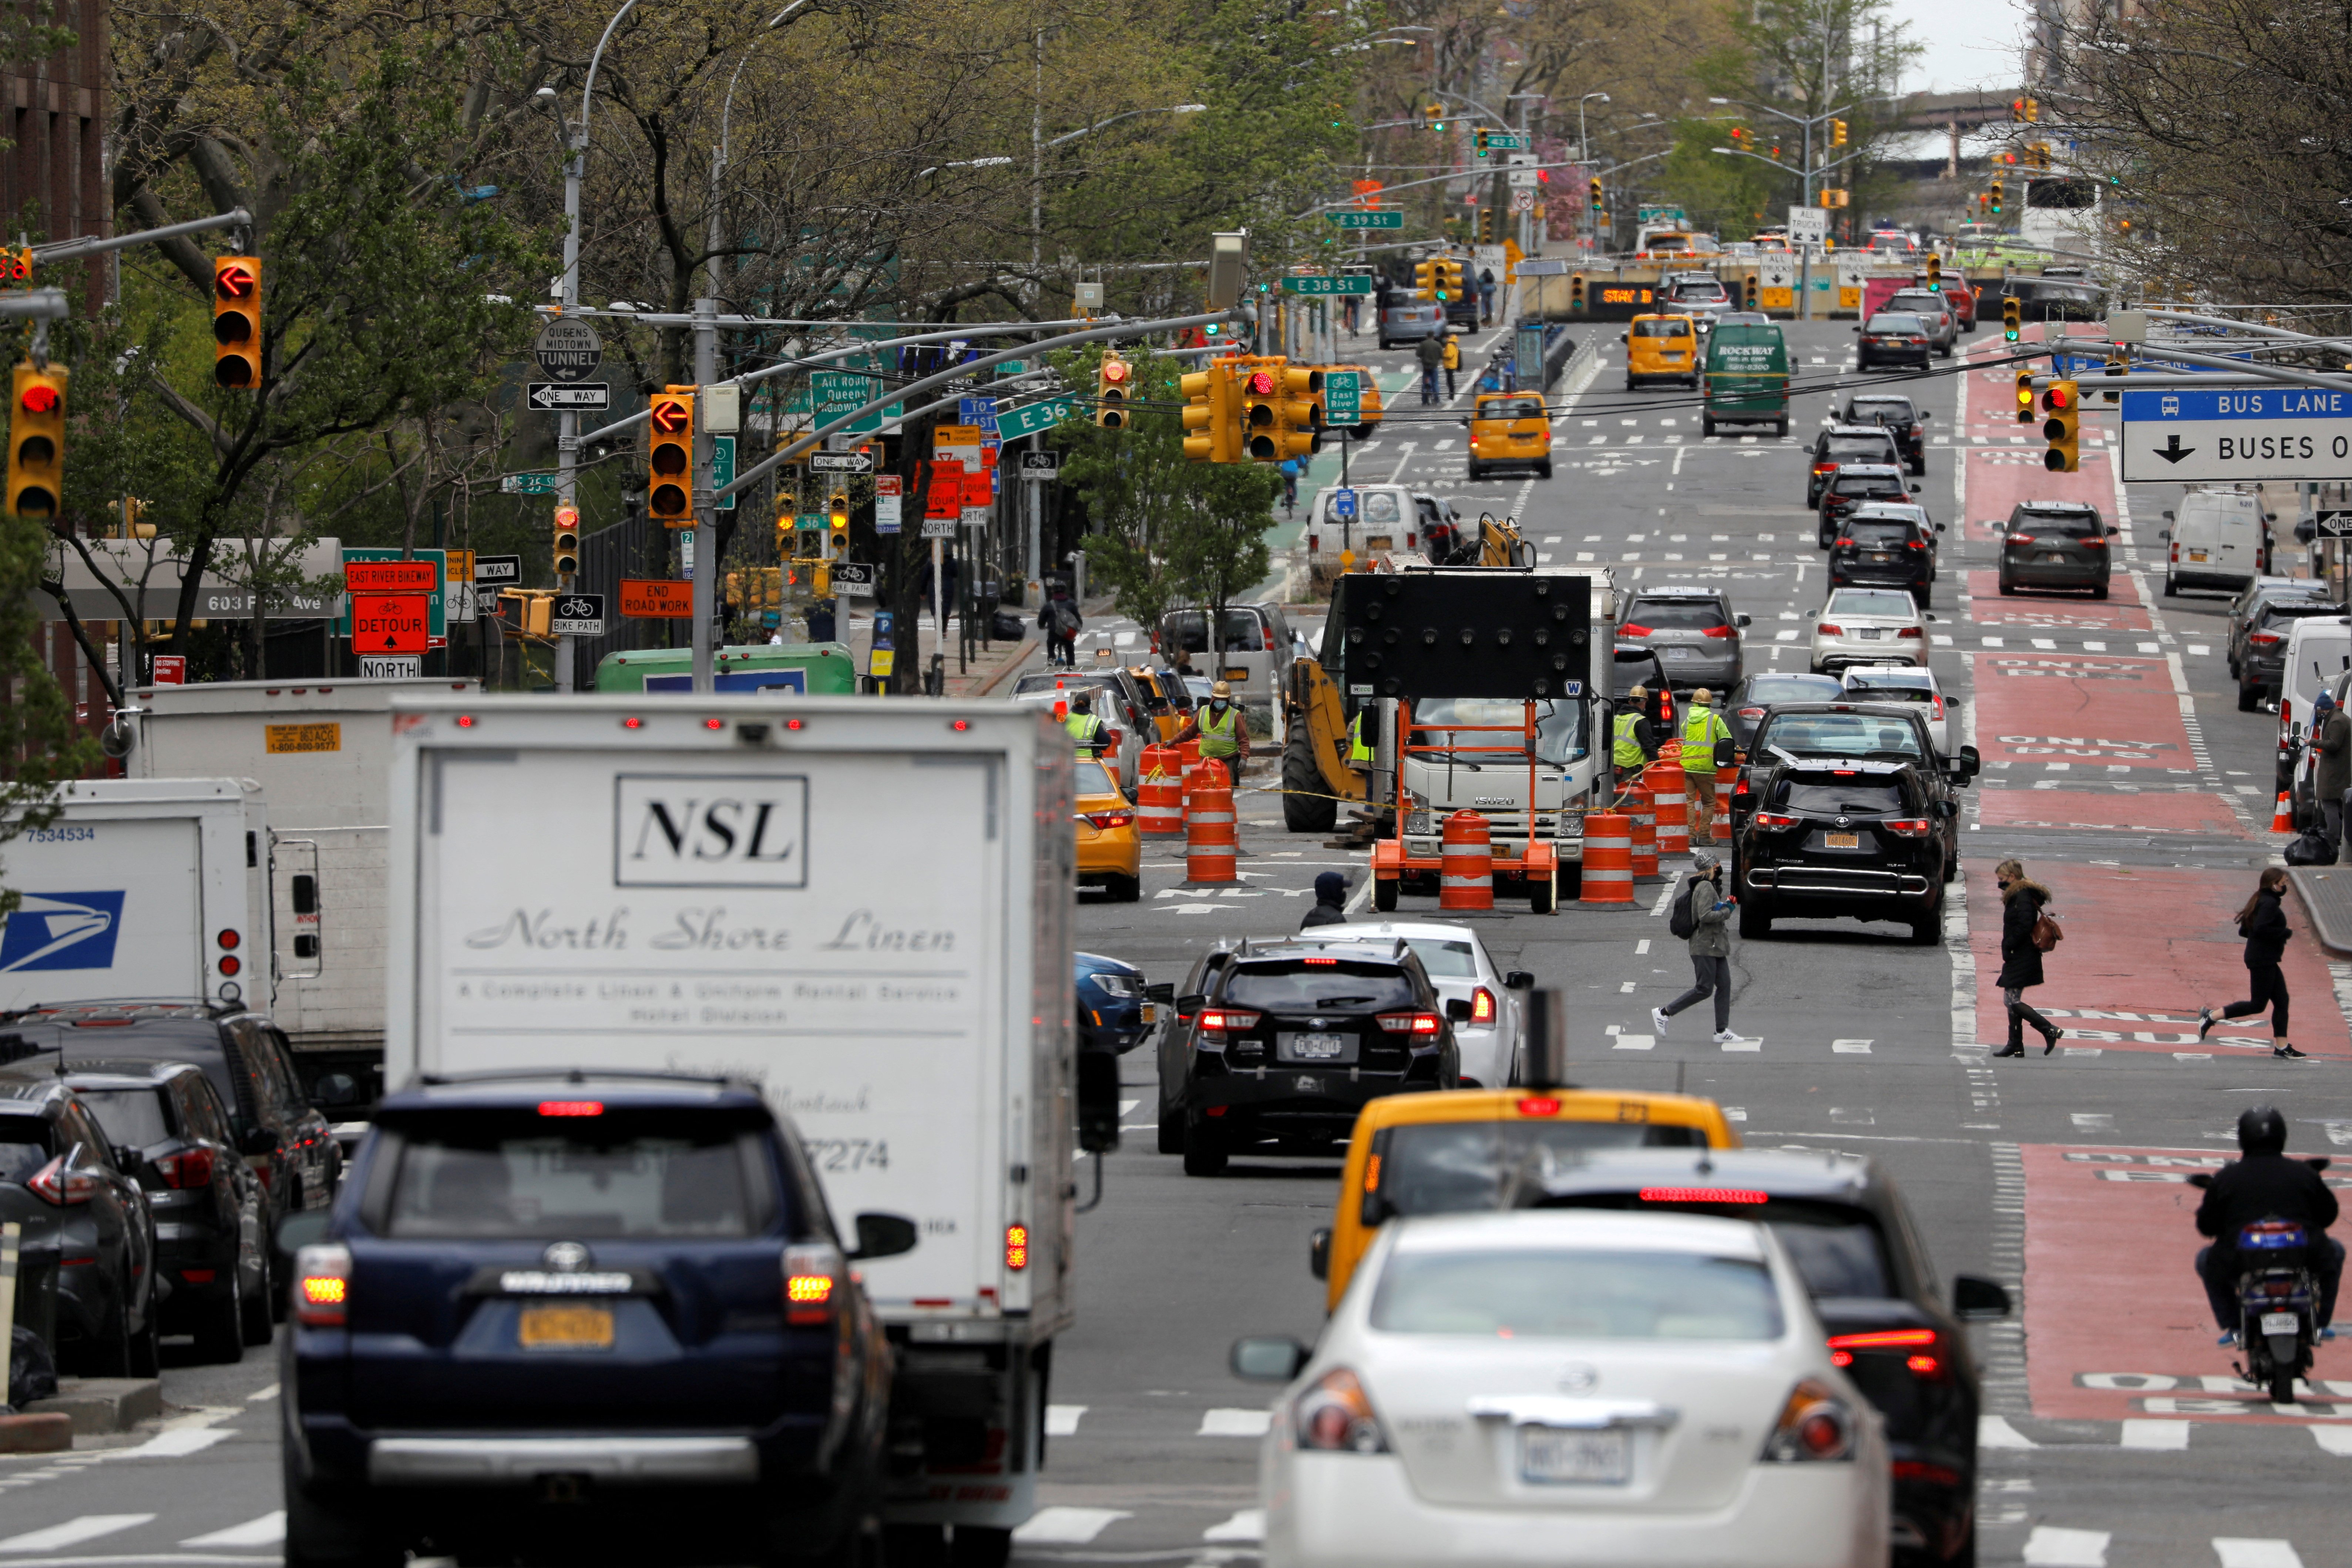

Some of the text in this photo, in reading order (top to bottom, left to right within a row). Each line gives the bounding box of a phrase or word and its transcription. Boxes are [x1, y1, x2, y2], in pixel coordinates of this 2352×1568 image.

[1490, 138, 1506, 146] 42
[1340, 215, 1388, 225] E 39 St
[1800, 210, 1815, 218] ALL
[1792, 219, 1822, 229] TRUCKS
[1298, 279, 1354, 292] E 38 St
[549, 328, 588, 338] QUEENS
[546, 340, 591, 349] MIDTOWN
[539, 352, 597, 366] TUNNEL
[822, 377, 836, 387] Alt
[540, 392, 596, 401] ONE WAY
[827, 390, 867, 401] Queens
[970, 400, 987, 412] TO
[2219, 394, 2342, 413] BUS LANE
[964, 417, 993, 427] EAST
[1020, 412, 1035, 429] E
[1041, 403, 1067, 422] 36
[2219, 436, 2314, 460] BUSES
[816, 458, 867, 466] ONE WAY
[528, 477, 541, 491] 35
[2329, 518, 2352, 529] ONE
[684, 534, 690, 543] 2
[487, 564, 510, 576] WAY
[350, 570, 431, 583] EAST RIVER BIKEWAY
[647, 585, 669, 597] END
[833, 583, 868, 593] BIKE PATH
[208, 596, 242, 610] 603
[293, 595, 321, 610] Ave
[625, 599, 689, 612] ROAD WORK
[359, 618, 422, 632] DETOUR
[554, 621, 599, 631] BIKE PATH
[364, 661, 416, 677] NORTH
[1568, 682, 1581, 695] W
[1999, 735, 2167, 750] ONLY
[2015, 747, 2152, 758] BUS
[1475, 796, 1515, 805] ISUZU
[27, 828, 95, 843] 7534534
[629, 798, 794, 862] NSL
[1153, 888, 1316, 898] NLY
[297, 915, 319, 923] ANTHON
[463, 905, 957, 952] North Shore Linen
[483, 981, 586, 1001] Complete
[599, 983, 659, 1000] Linen
[695, 981, 782, 1001] Uniform
[794, 981, 867, 1001] Rental
[877, 983, 960, 1001] Service
[700, 1007, 788, 1024] Division
[2060, 1028, 2271, 1047] BUS
